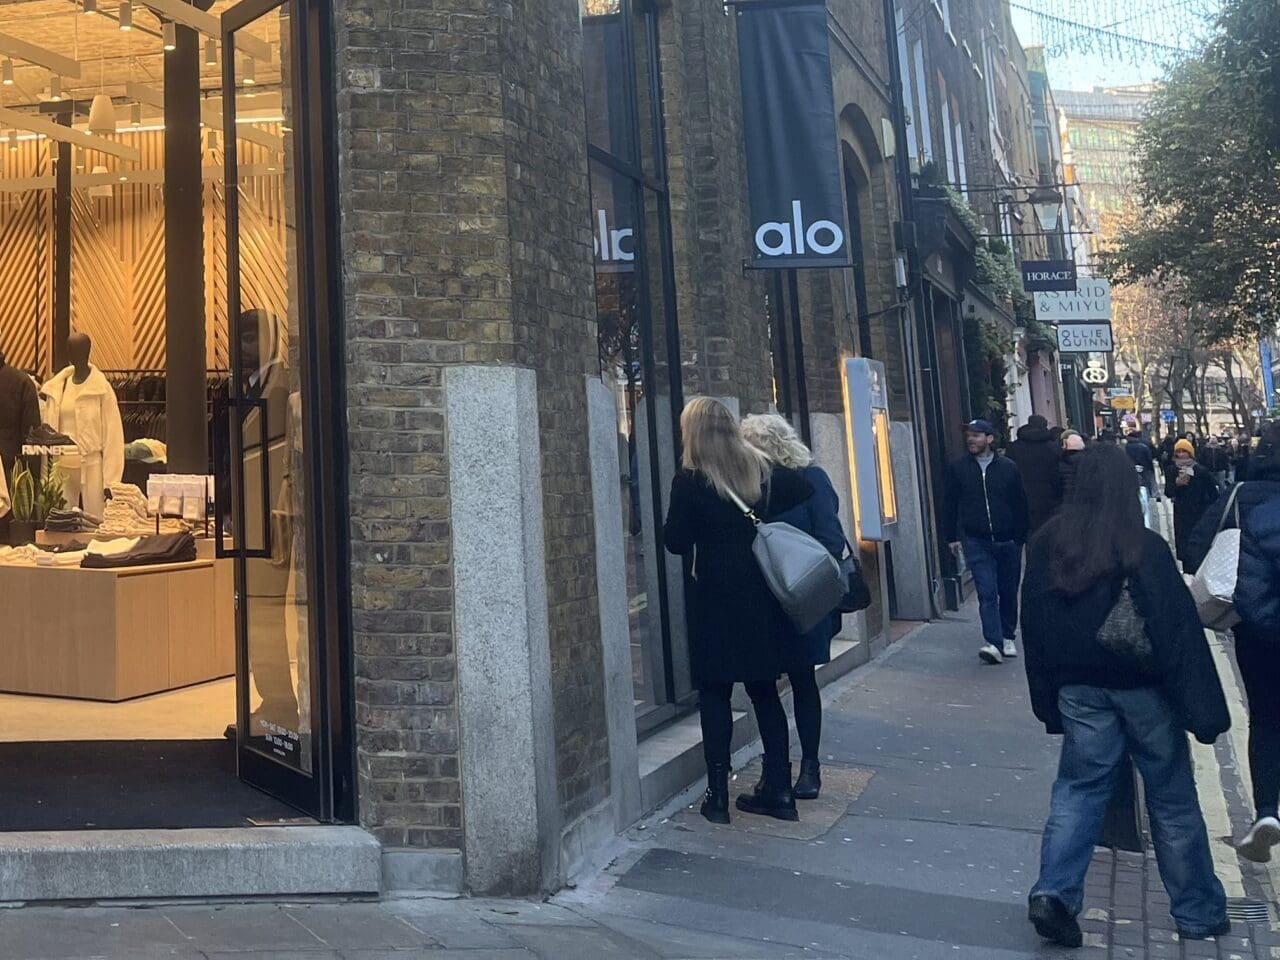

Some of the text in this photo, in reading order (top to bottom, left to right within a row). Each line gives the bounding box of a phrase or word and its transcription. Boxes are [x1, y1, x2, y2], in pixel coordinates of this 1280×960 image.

[755, 200, 843, 256] alo
[1027, 271, 1072, 281] HORACE
[1040, 300, 1105, 313] & MIYU
[1061, 329, 1102, 339] OLLIE
[1062, 338, 1109, 347] QUINN
